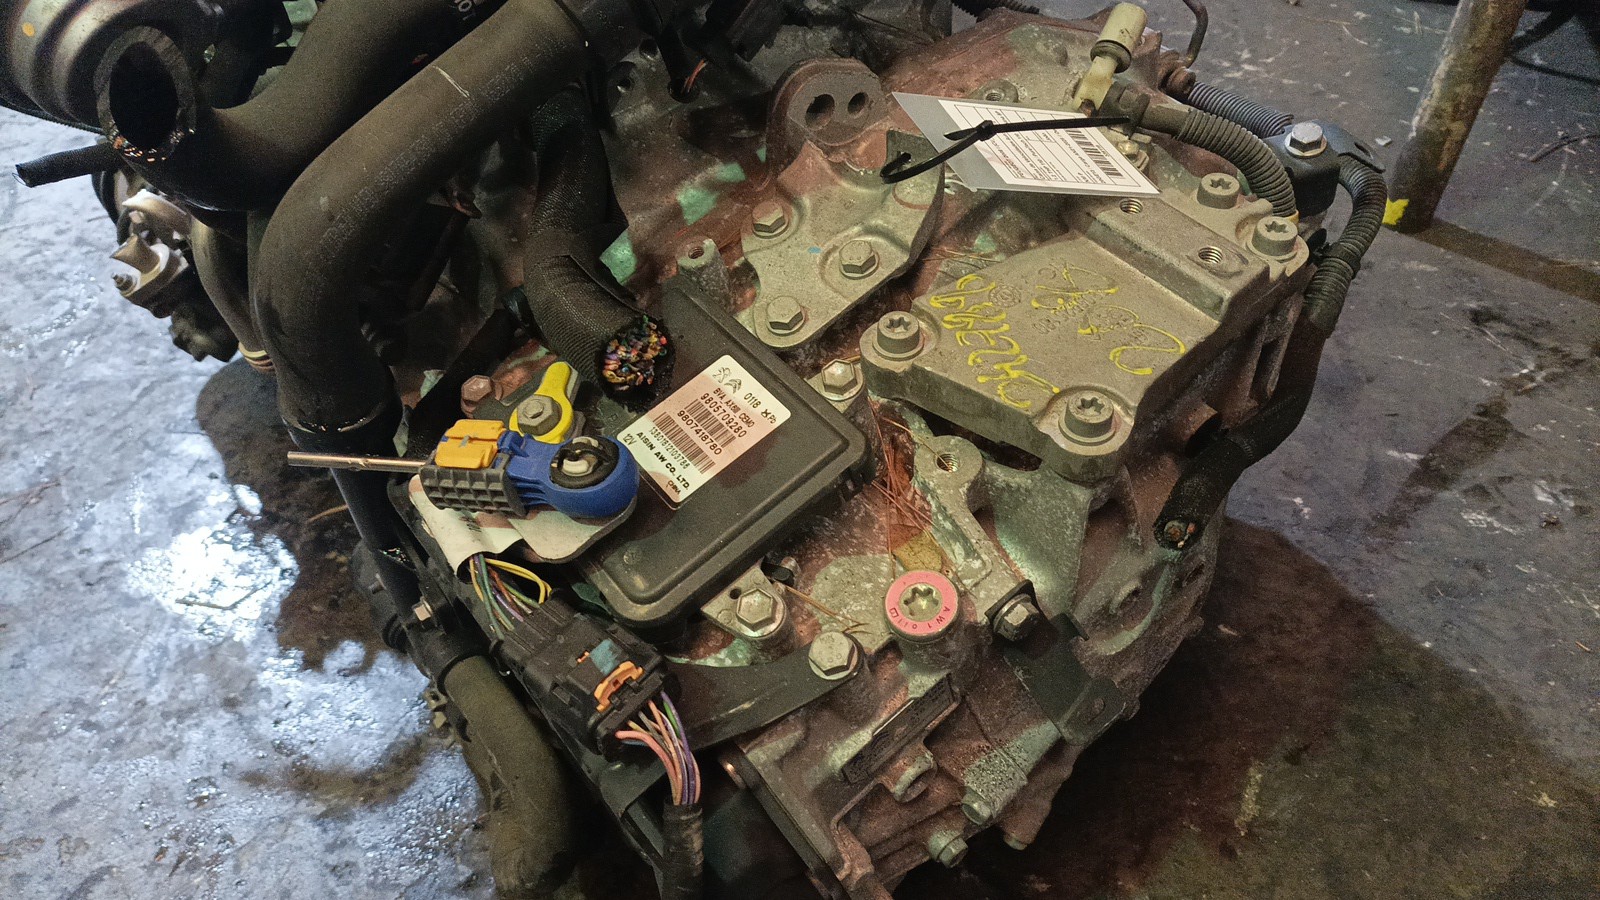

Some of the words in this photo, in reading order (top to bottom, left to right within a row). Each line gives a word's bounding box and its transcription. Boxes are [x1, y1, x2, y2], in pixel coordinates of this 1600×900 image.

[700, 392, 747, 438] 9805709280
[743, 392, 762, 409] 0118
[622, 433, 637, 446] 12V
[677, 410, 723, 456] 9807418780
[636, 431, 656, 452] AISIN
[654, 451, 668, 464] AW
[676, 474, 691, 491] LTD.
